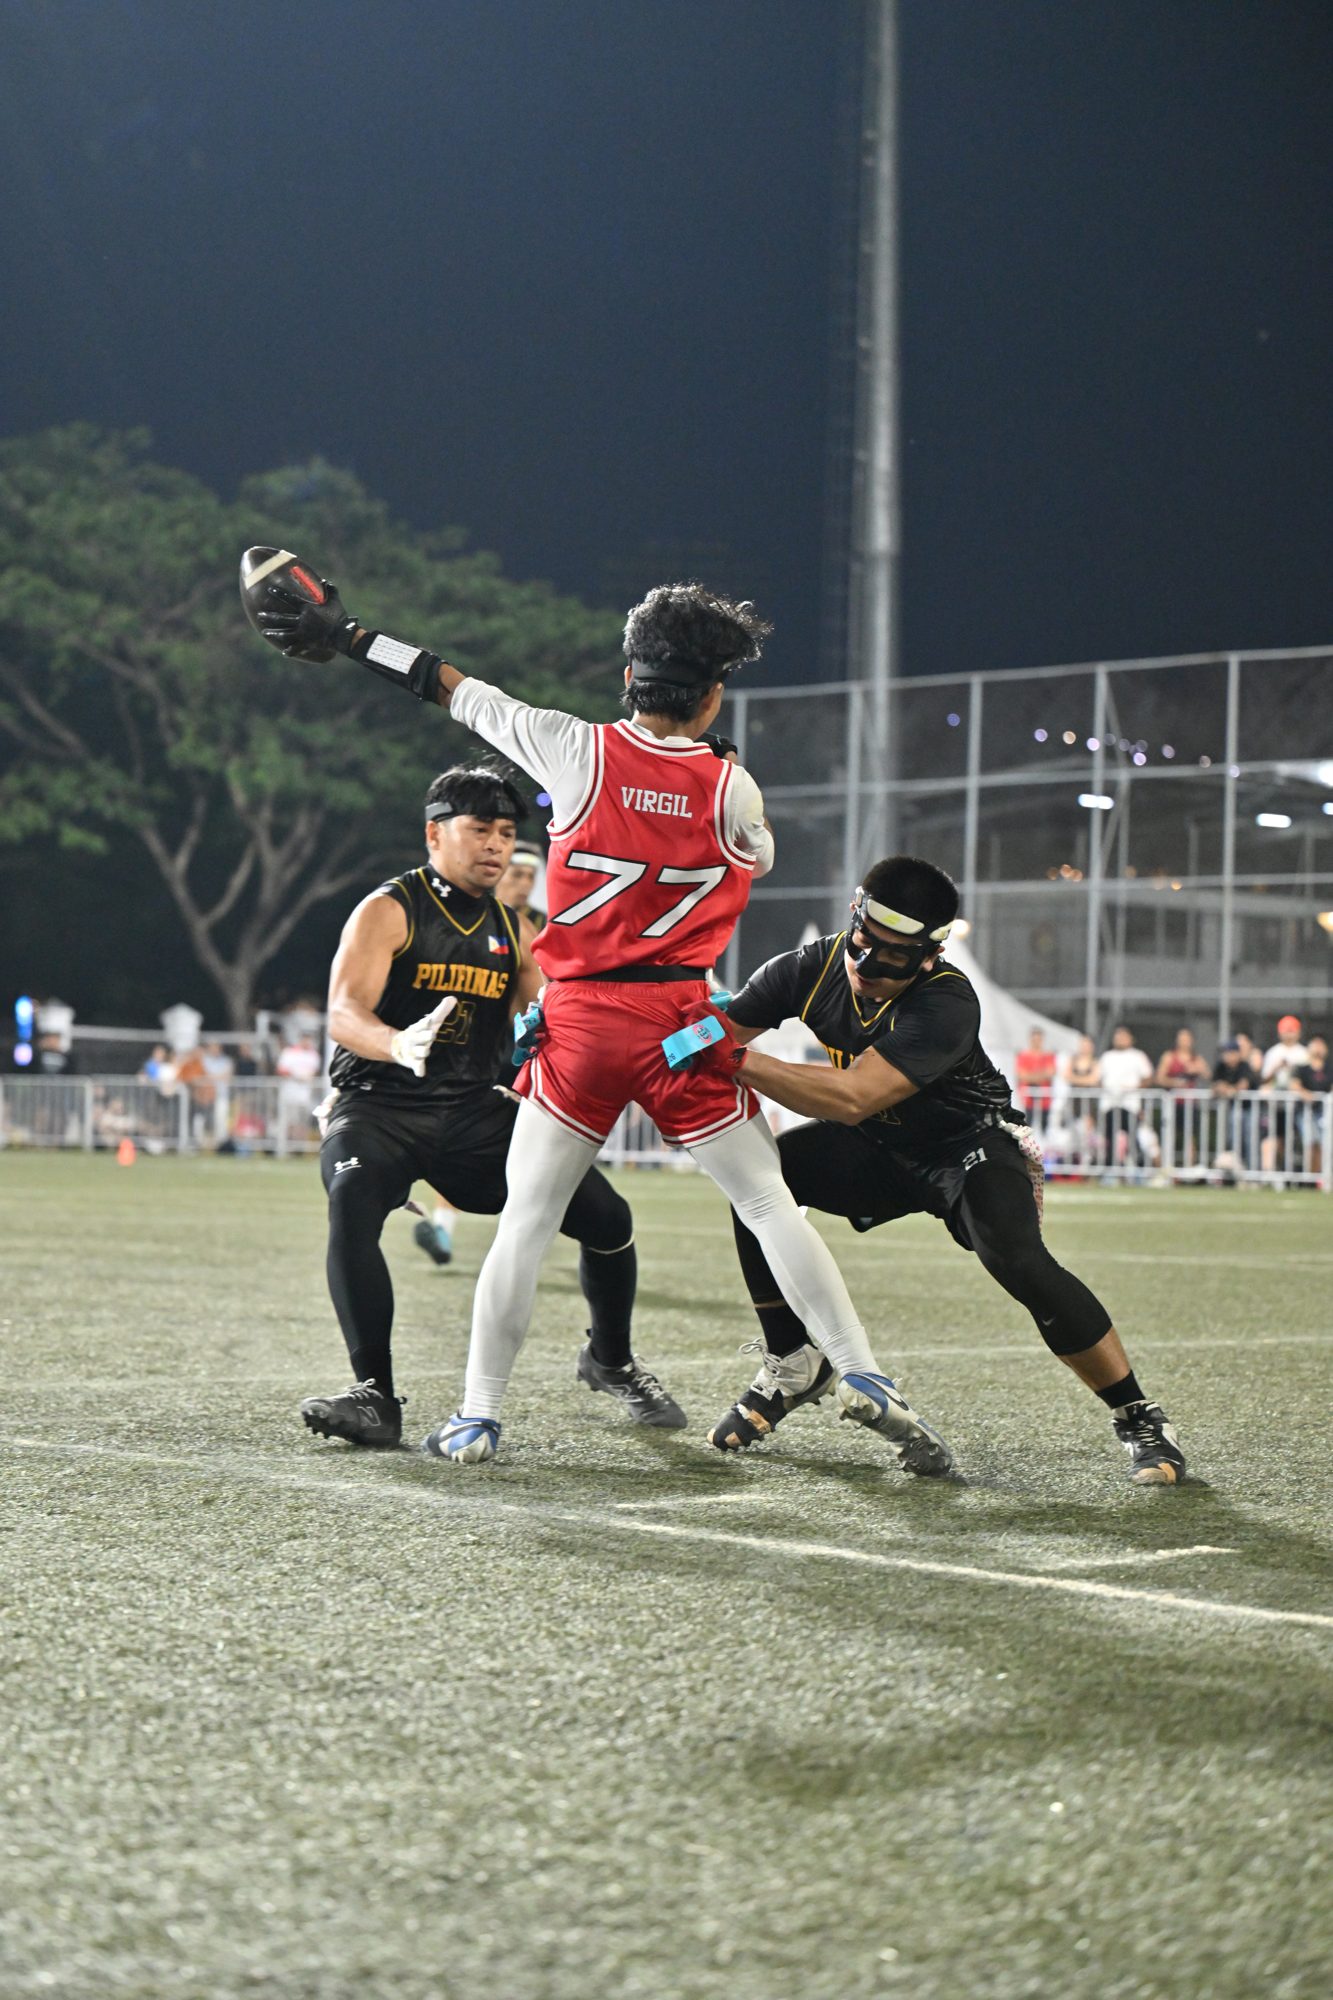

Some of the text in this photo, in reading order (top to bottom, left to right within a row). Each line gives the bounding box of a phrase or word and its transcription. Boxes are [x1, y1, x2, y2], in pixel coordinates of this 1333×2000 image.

[621, 785, 693, 819] VIRGIL
[550, 850, 729, 938] 77
[962, 1147, 988, 1171] 21
